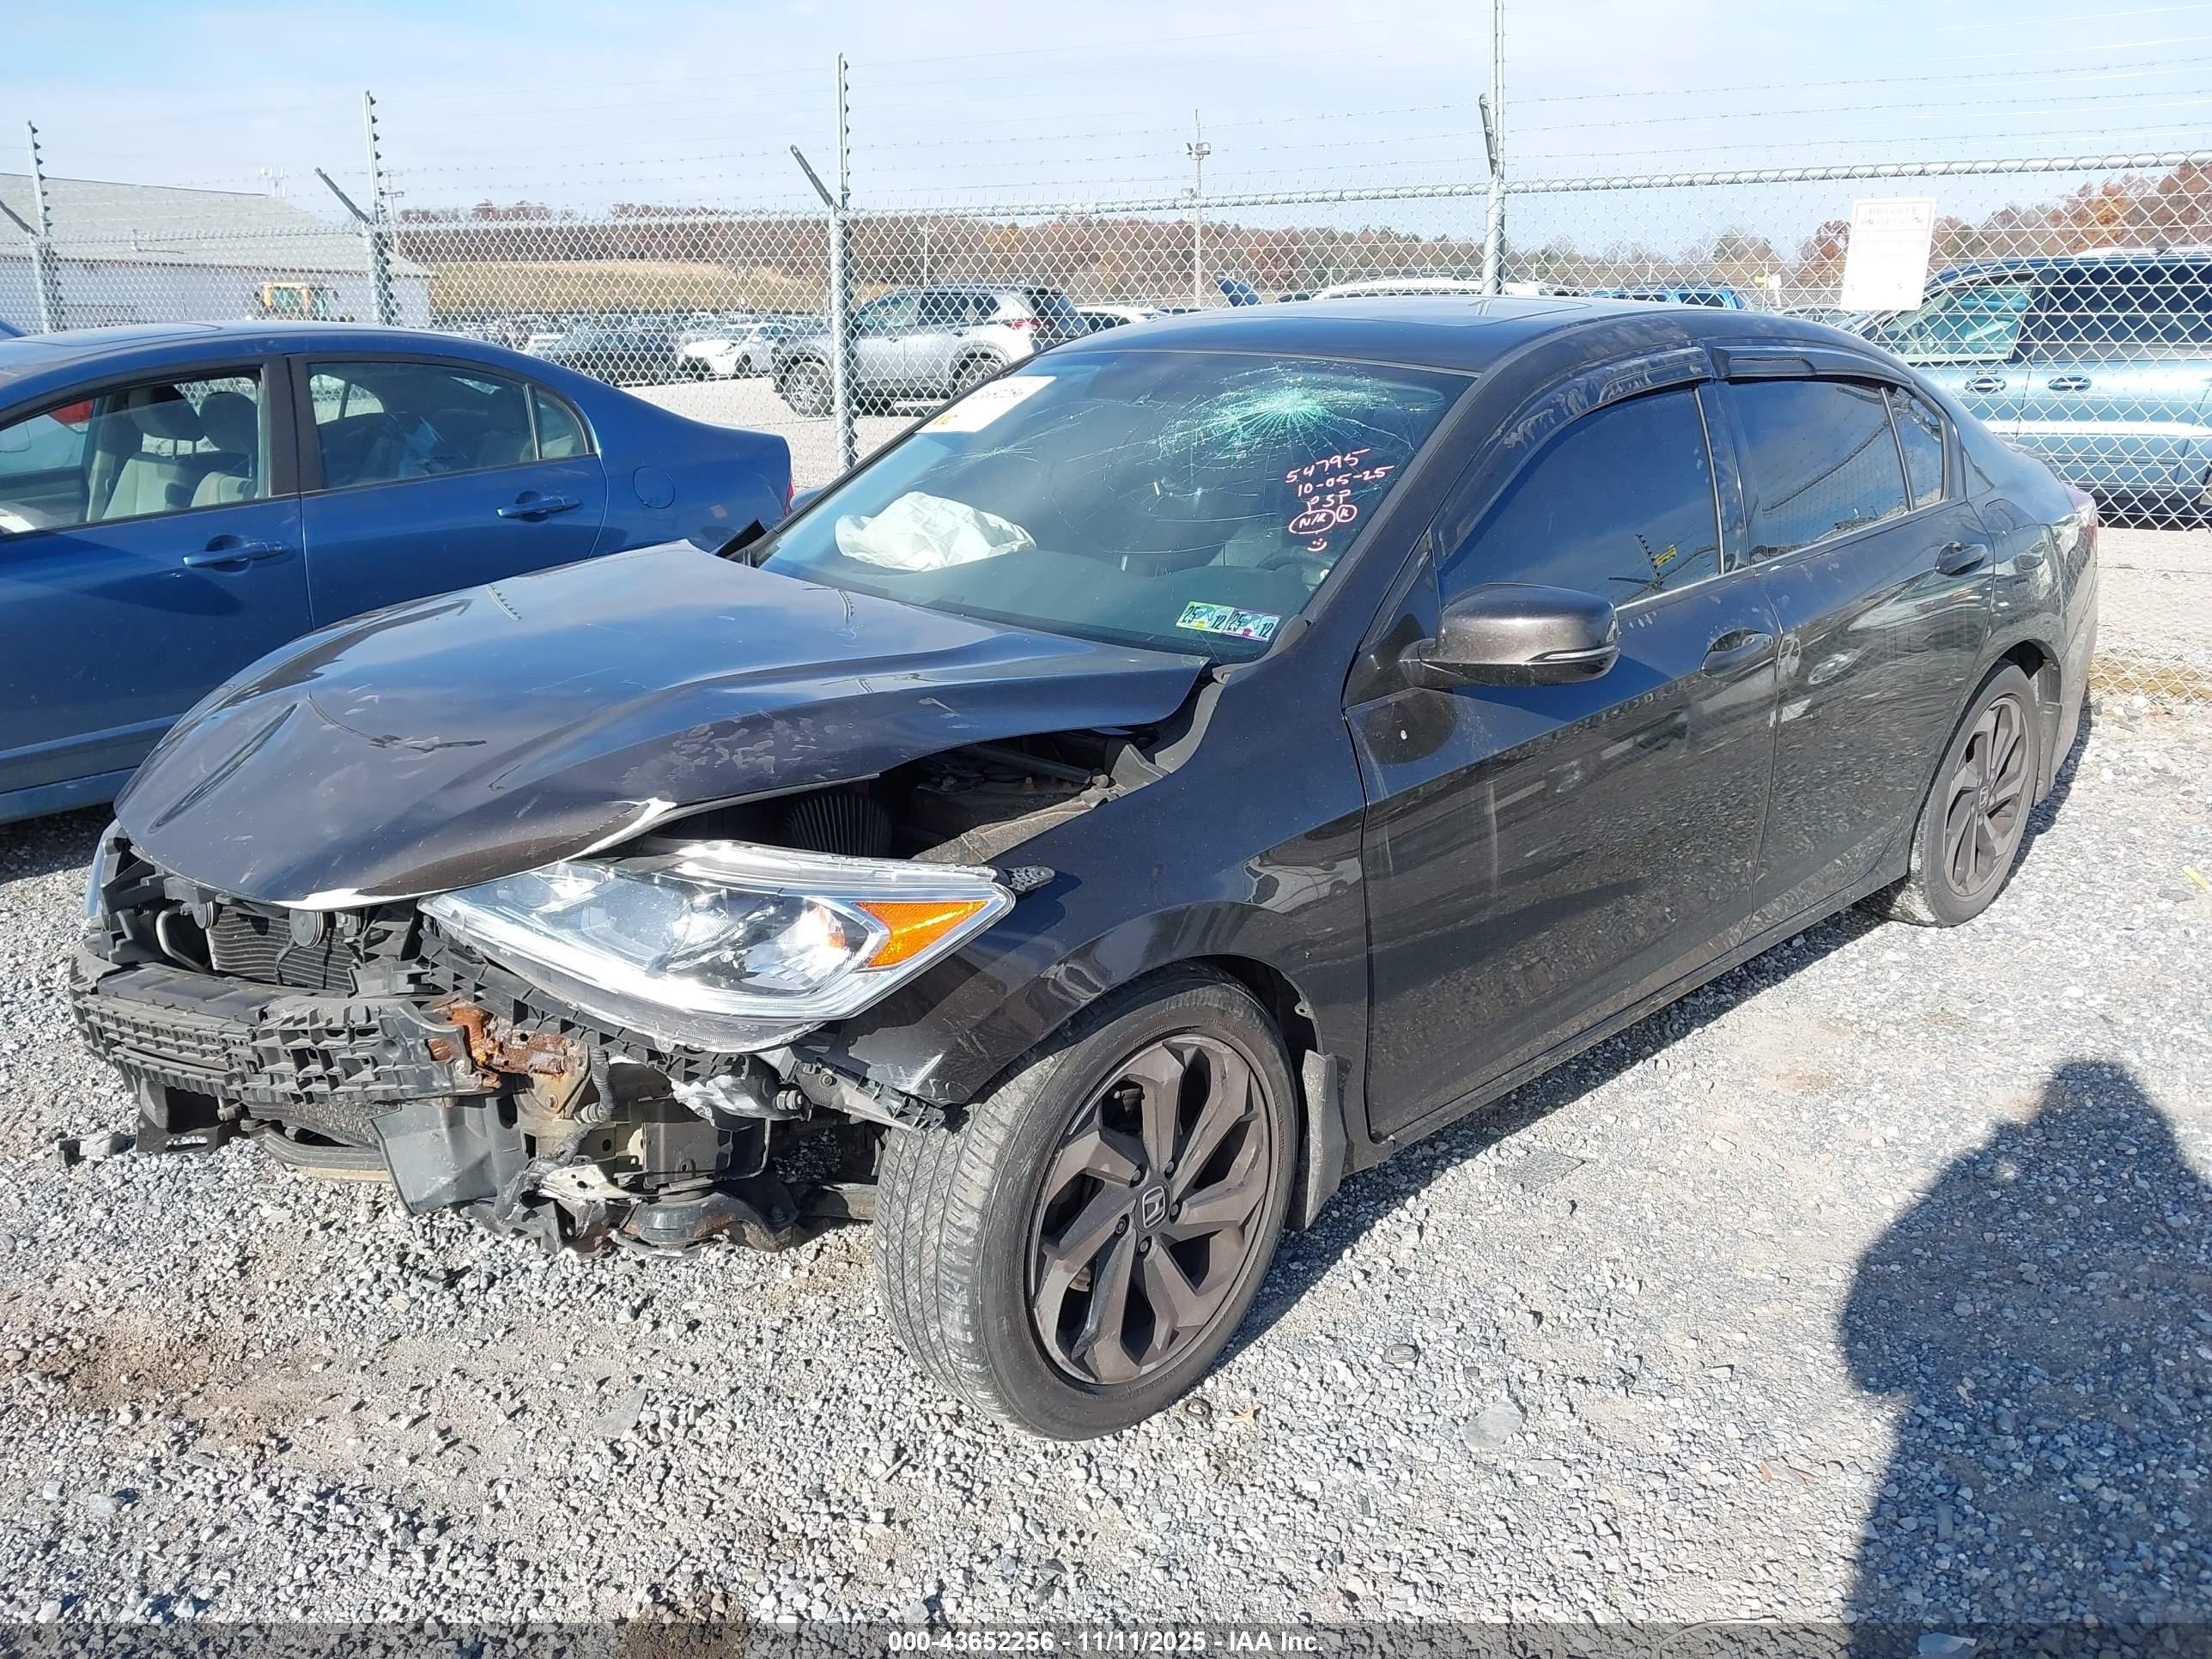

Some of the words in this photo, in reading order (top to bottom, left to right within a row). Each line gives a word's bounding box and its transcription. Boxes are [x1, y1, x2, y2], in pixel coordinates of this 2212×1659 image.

[1861, 217, 1923, 227] PROPE
[1869, 206, 1918, 216] PRIVATE
[1285, 447, 1370, 483] 54795
[1183, 605, 1200, 624] 25
[1211, 614, 1227, 630] 12
[1228, 612, 1246, 631] 25
[1257, 622, 1274, 638] 12
